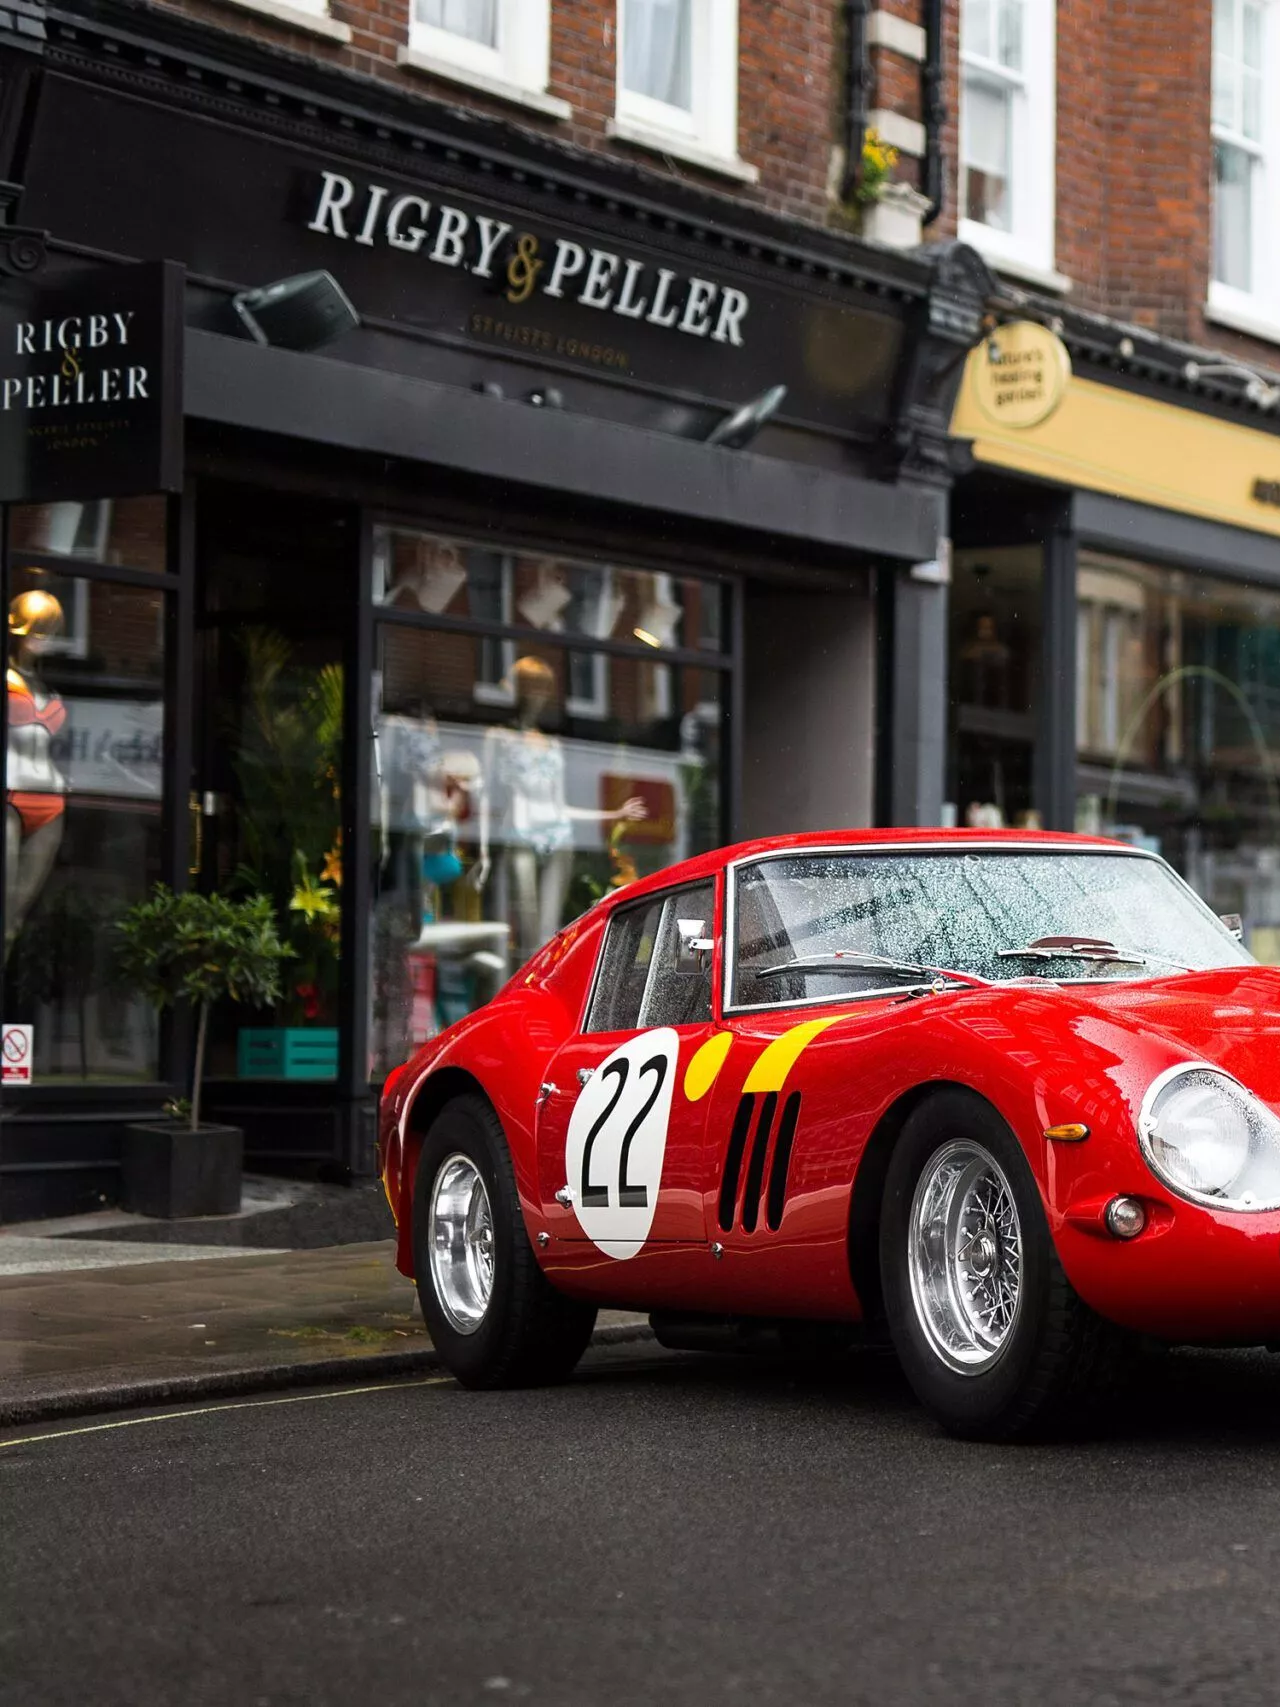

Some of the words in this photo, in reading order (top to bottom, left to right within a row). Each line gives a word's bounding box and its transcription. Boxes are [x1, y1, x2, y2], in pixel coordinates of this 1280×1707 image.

[308, 170, 512, 278] RIGBY
[506, 230, 544, 301] &
[543, 238, 749, 346] PELLER
[16, 311, 134, 354] RIGBY
[3, 366, 149, 410] PELLER
[61, 346, 81, 386] &
[581, 1054, 658, 1207] 22
